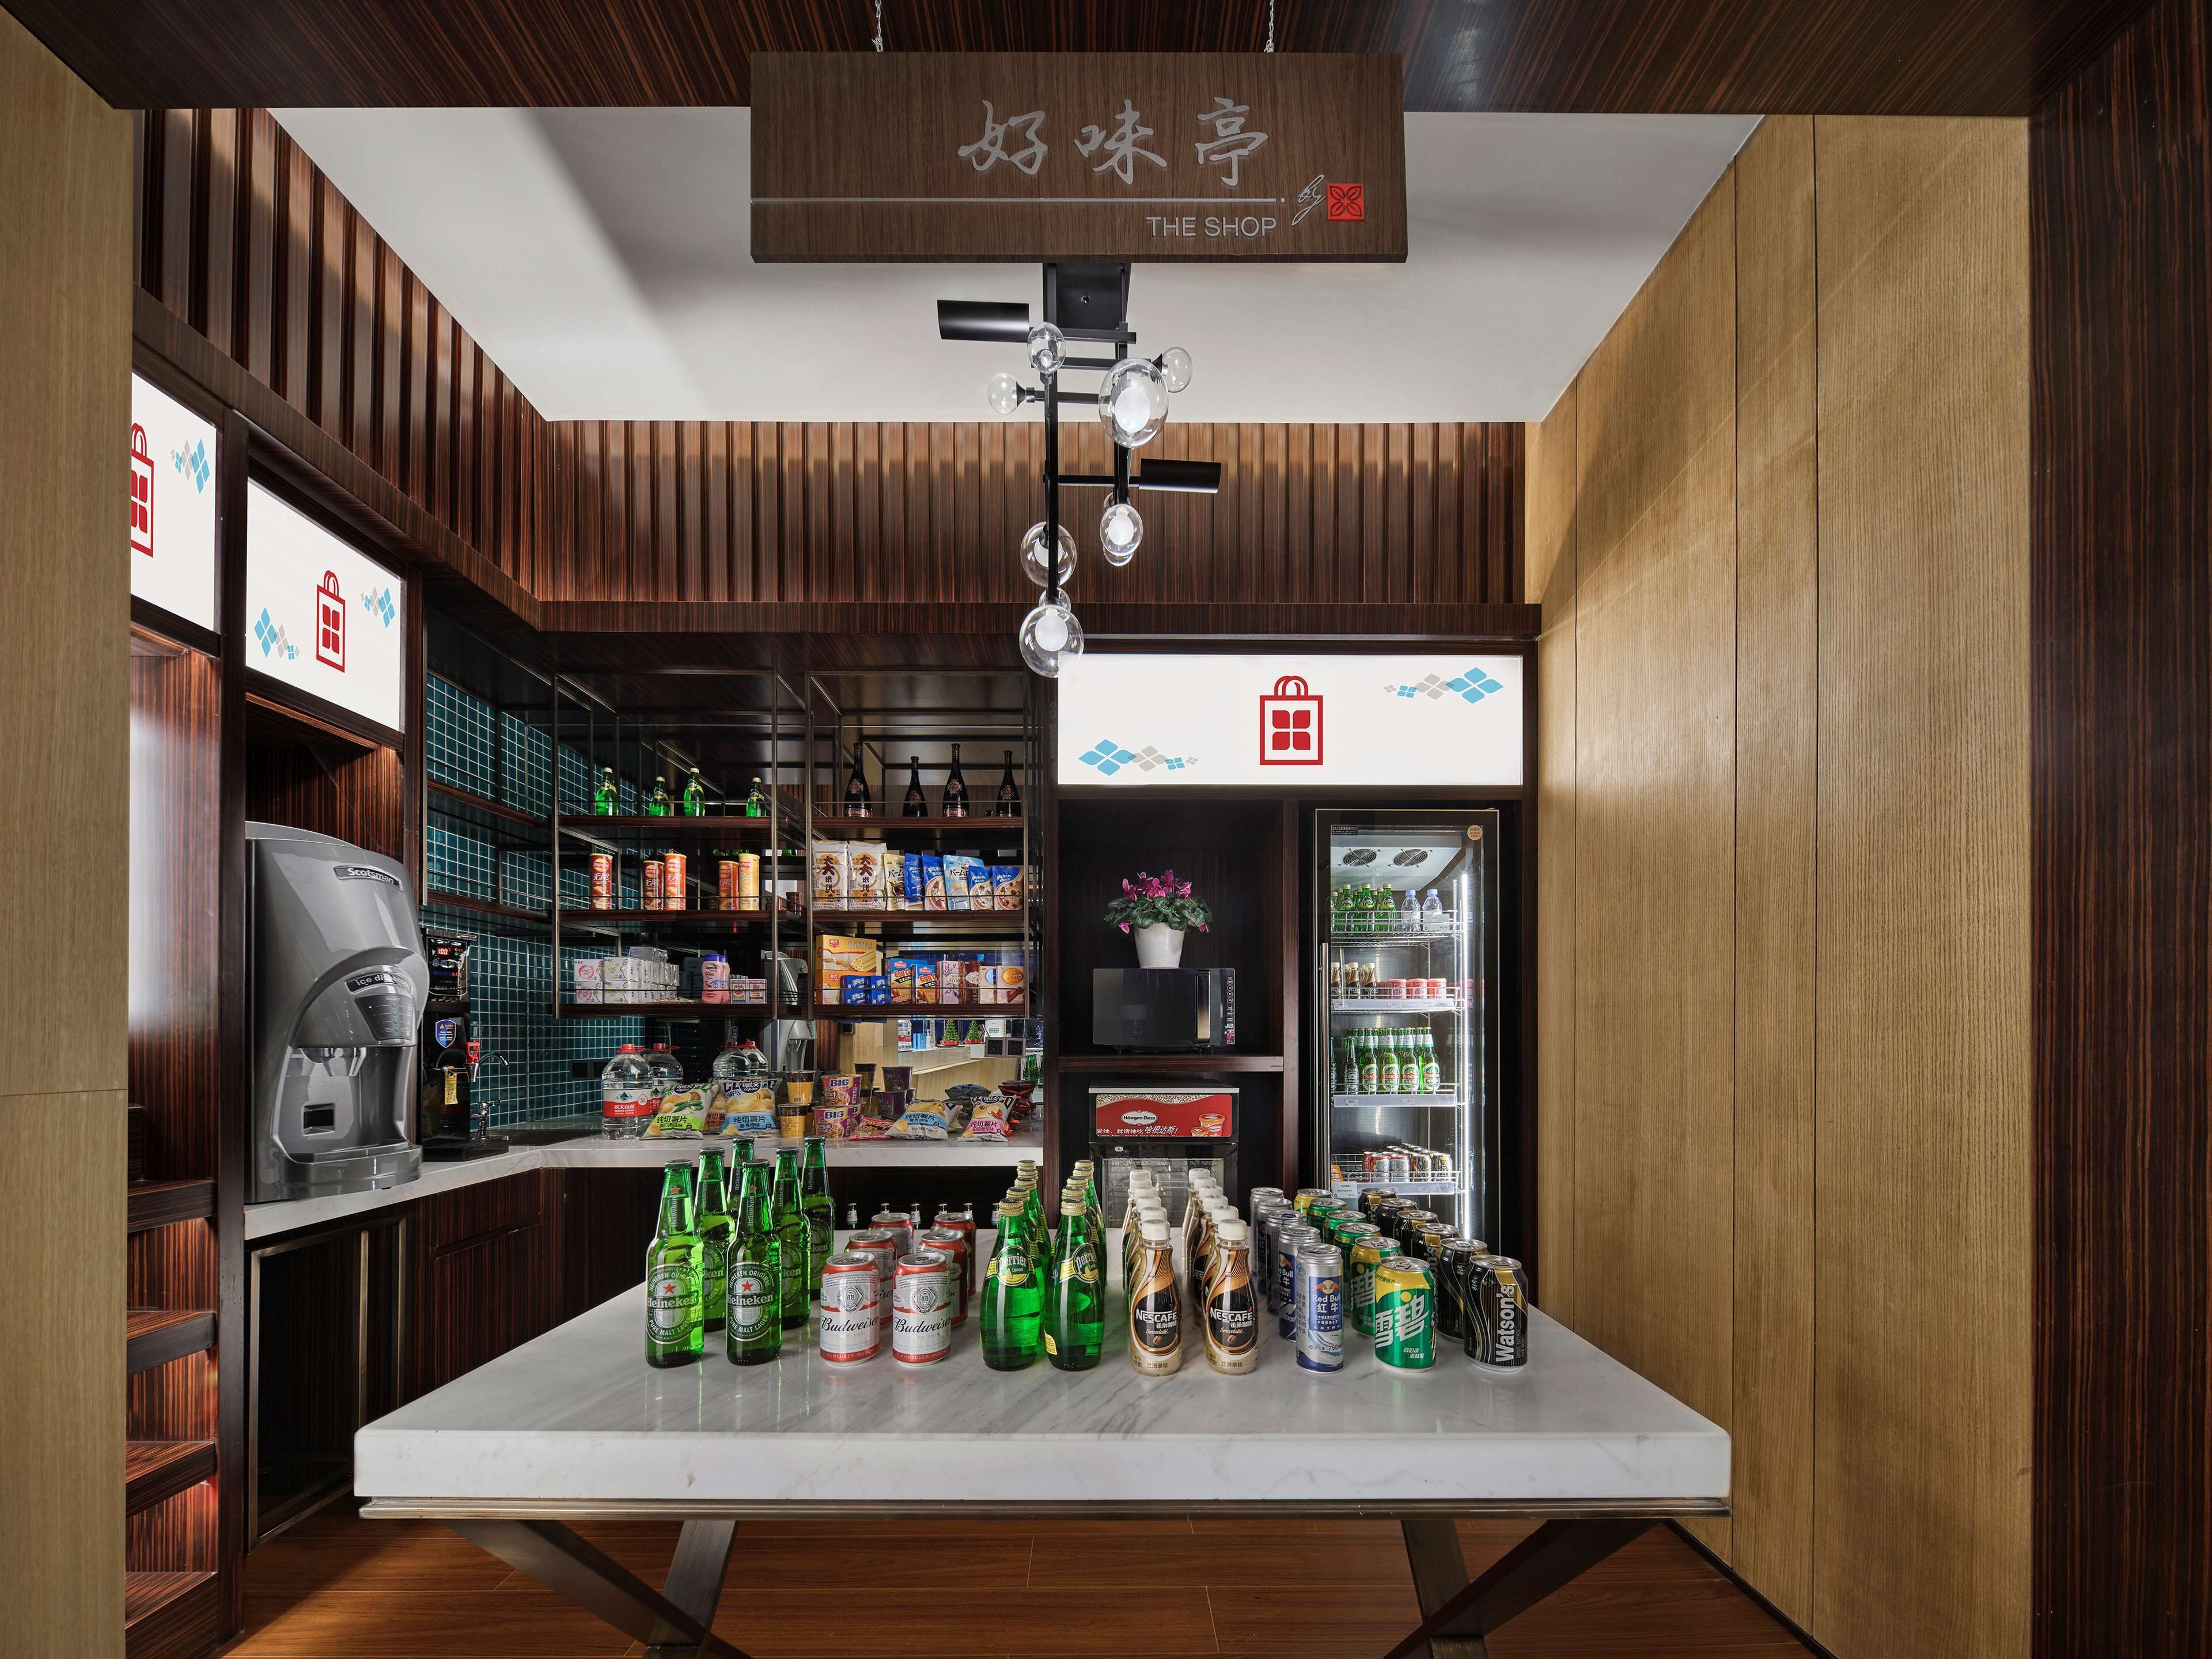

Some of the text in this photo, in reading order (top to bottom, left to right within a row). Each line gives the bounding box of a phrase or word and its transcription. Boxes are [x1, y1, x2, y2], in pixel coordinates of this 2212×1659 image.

[957, 97, 1268, 186] 好味亭
[1146, 217, 1277, 237] THE SHOP
[347, 868, 394, 884] Scotsman
[355, 977, 373, 986] ice
[733, 1115, 766, 1124] 纯切薯片
[824, 1111, 844, 1119] BIG
[649, 1272, 668, 1291] HEINEKEN
[729, 1270, 747, 1289] HEINEKEN
[1282, 1269, 1293, 1278] Bull
[647, 1297, 697, 1308] Heineken
[728, 1294, 774, 1305] Heineken
[1313, 1294, 1328, 1302] Red
[1317, 1302, 1338, 1313] 红牛
[649, 1320, 659, 1333] PURE
[755, 1315, 769, 1331] LAGER
[821, 1315, 880, 1332] Budweiser
[894, 1316, 950, 1333] Budweiser
[1375, 1294, 1429, 1349] 雪碧
[1496, 1285, 1515, 1362] Watson's
